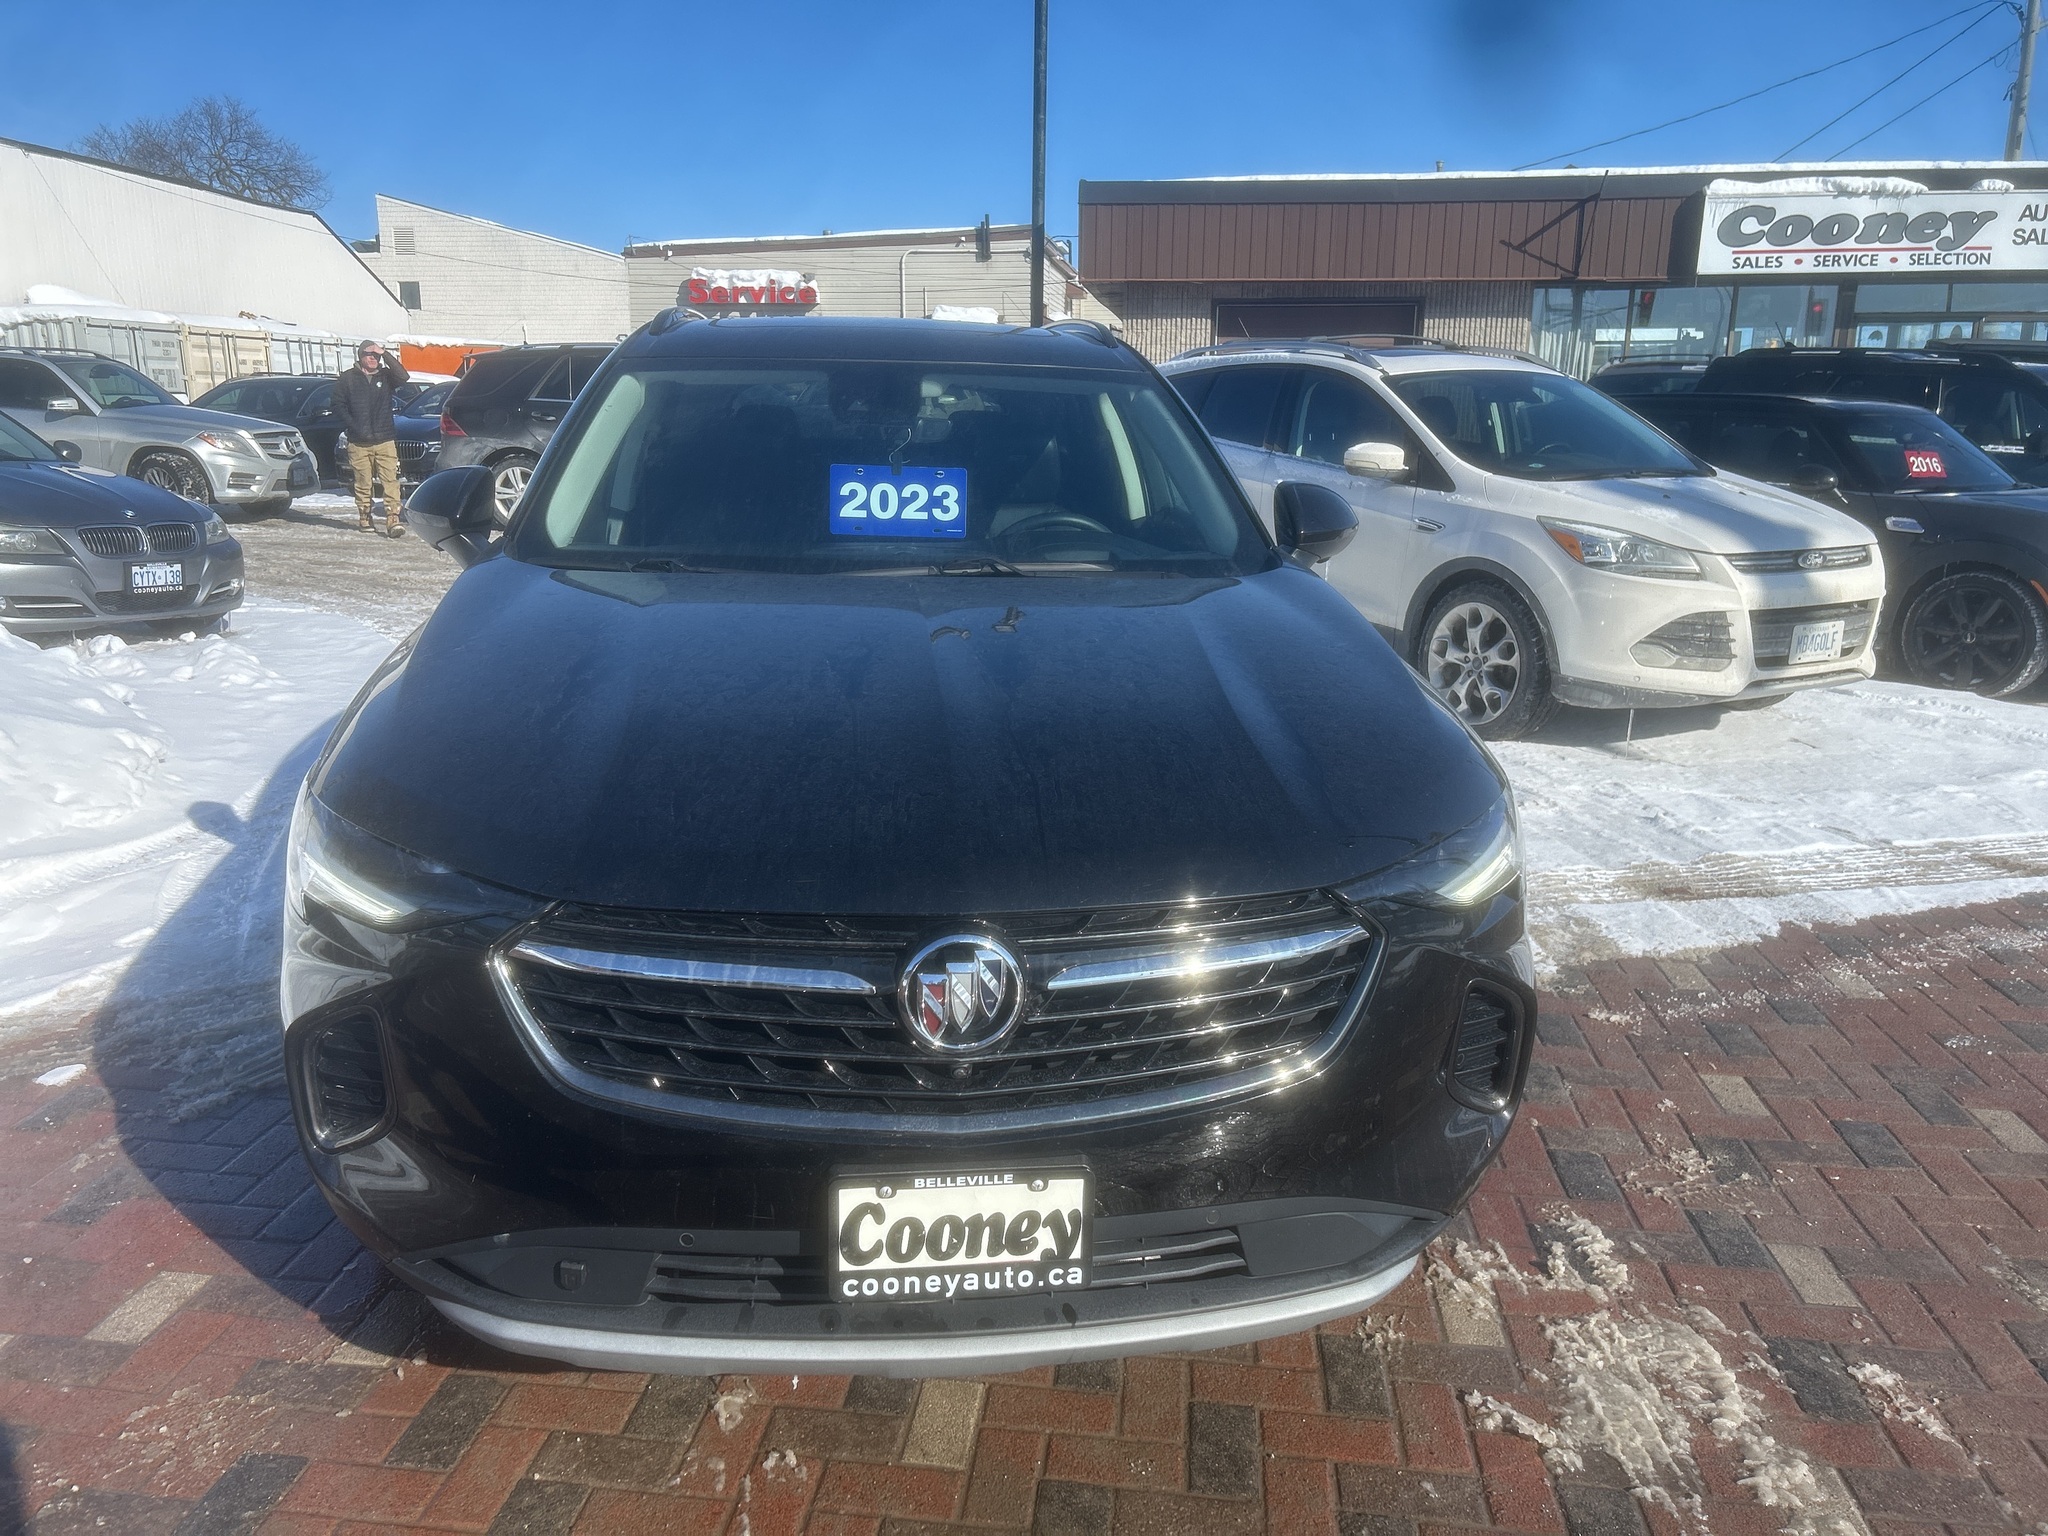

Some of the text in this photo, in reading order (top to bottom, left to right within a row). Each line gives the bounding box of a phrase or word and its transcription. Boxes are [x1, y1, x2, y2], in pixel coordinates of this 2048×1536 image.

[1717, 205, 1998, 251] Cooney
[1732, 252, 1991, 269] SALES SERVICE SELECTION
[688, 278, 818, 304] Service
[1910, 456, 1942, 473] 2016
[839, 481, 960, 522] 2023
[133, 569, 181, 586] CYTX 138
[914, 1174, 1014, 1188] BELLEVILLE
[840, 1202, 1082, 1266] Cooney
[842, 1266, 1083, 1297] cooneyauto.ca
